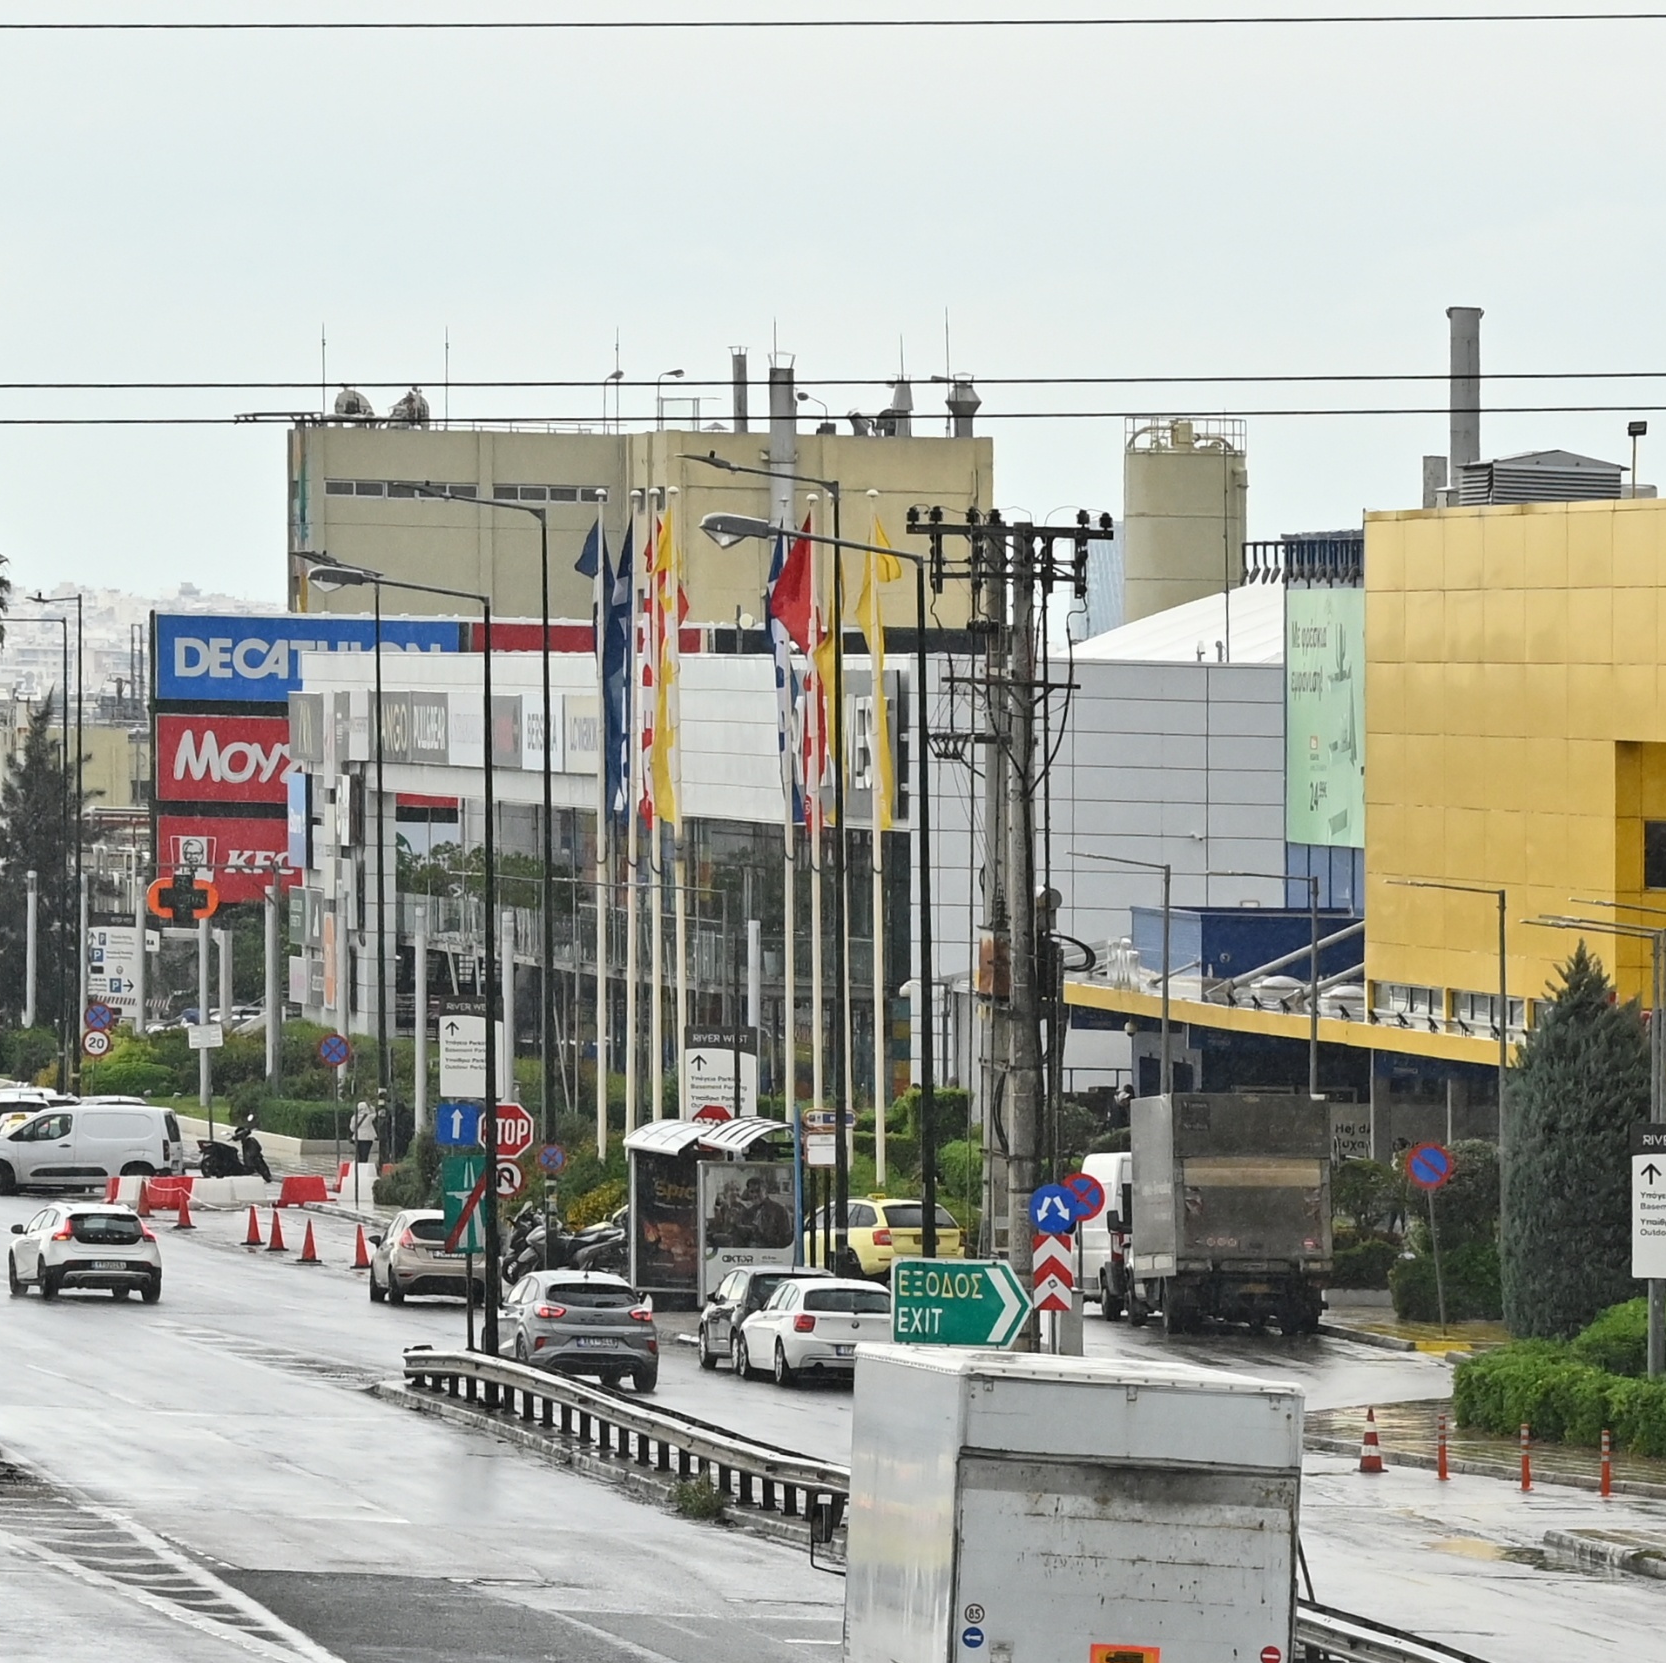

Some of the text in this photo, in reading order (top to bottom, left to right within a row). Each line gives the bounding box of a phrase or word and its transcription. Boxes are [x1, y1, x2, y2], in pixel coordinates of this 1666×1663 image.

[224, 850, 297, 874] KFC
[446, 1002, 472, 1011] RIVER
[88, 1036, 106, 1050] 20
[693, 1033, 749, 1044] RIVER WST
[484, 1117, 529, 1146] TOP
[898, 1270, 983, 1300] ΕΞΟΔΟΣ
[897, 1307, 944, 1334] EXIT
[968, 1608, 982, 1620] 85
